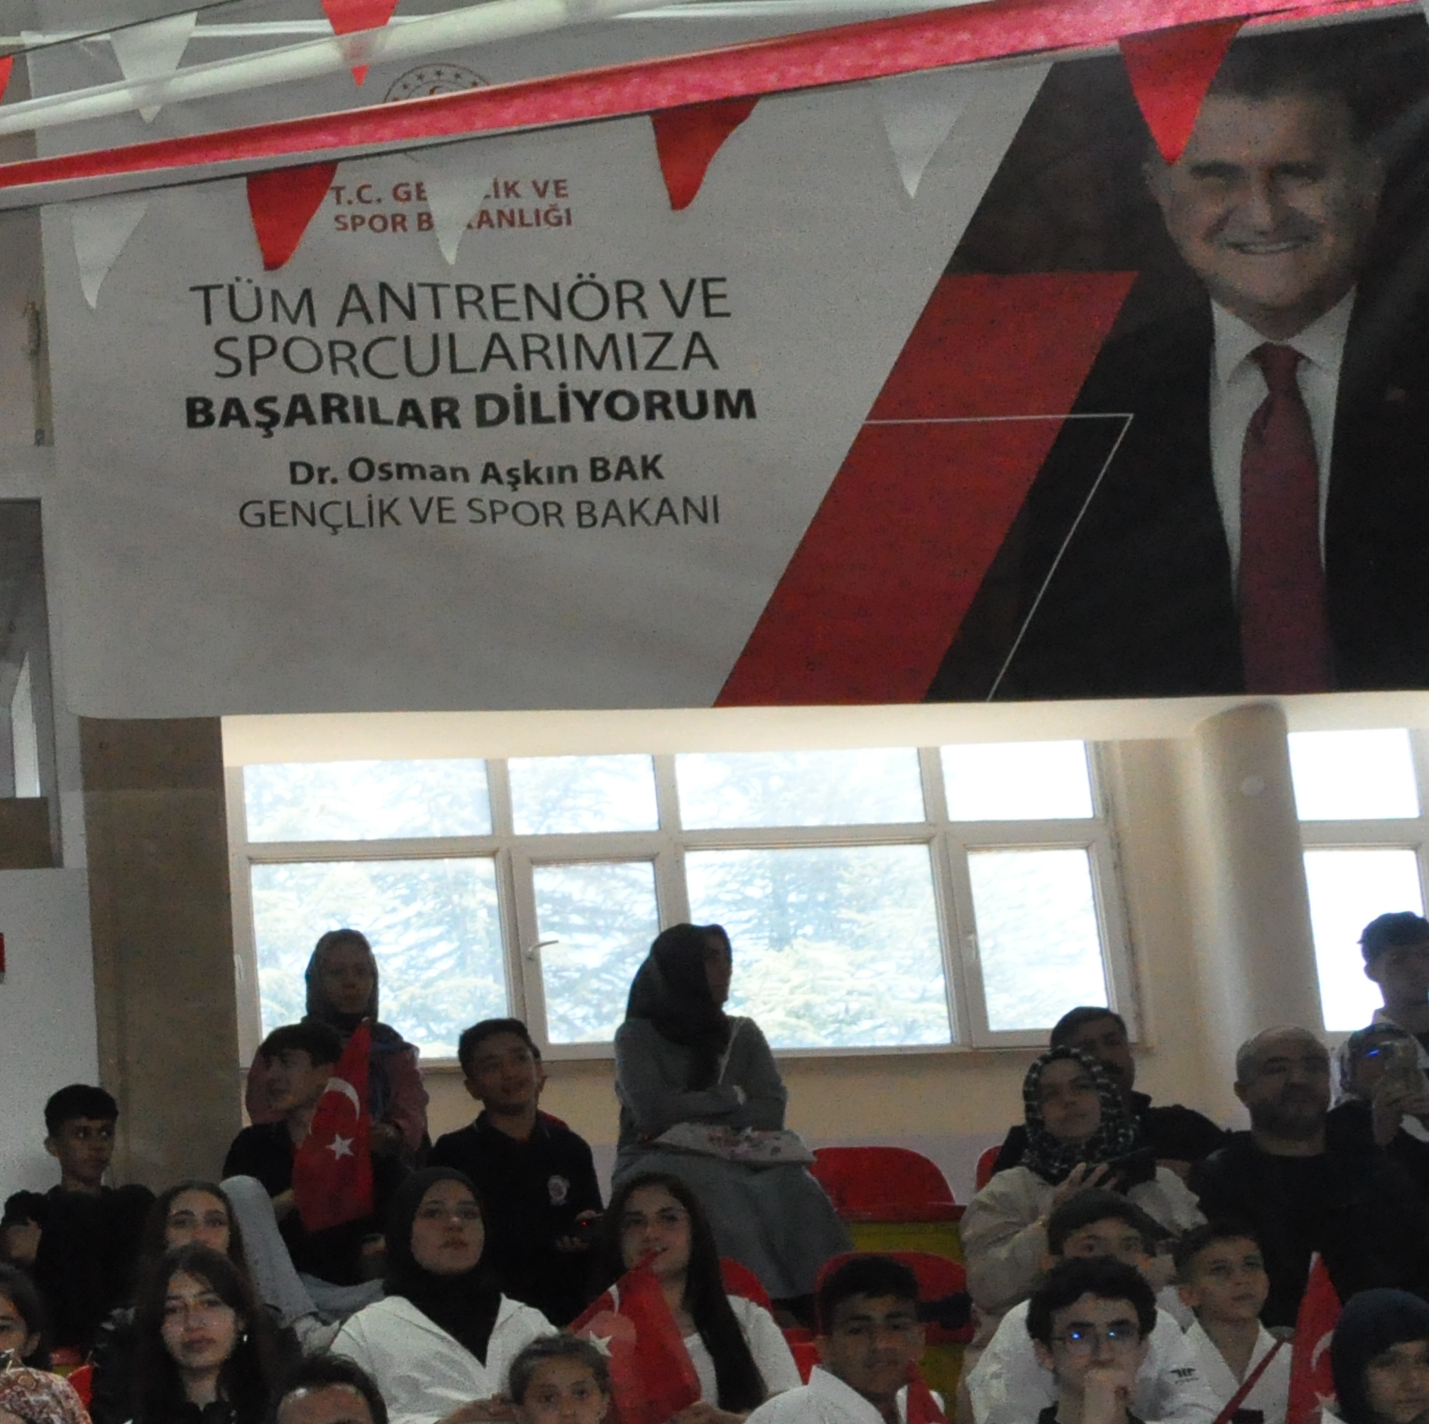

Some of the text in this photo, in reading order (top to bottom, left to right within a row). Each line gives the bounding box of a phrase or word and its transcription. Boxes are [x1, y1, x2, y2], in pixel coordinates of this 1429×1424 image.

[330, 176, 569, 206] T.C. GEİK VE
[334, 203, 572, 233] SPOR BANLIĞI
[189, 272, 733, 328] TÜM ANTRENÖR VE
[213, 330, 720, 380] SPORCULARIMIZA
[185, 382, 758, 438] BAŞARILAR DİLİYORUM
[288, 454, 664, 492] Dr. Osman Aşkın BAK
[238, 493, 720, 535] GENÇLİK VE SPOR BAKANI
